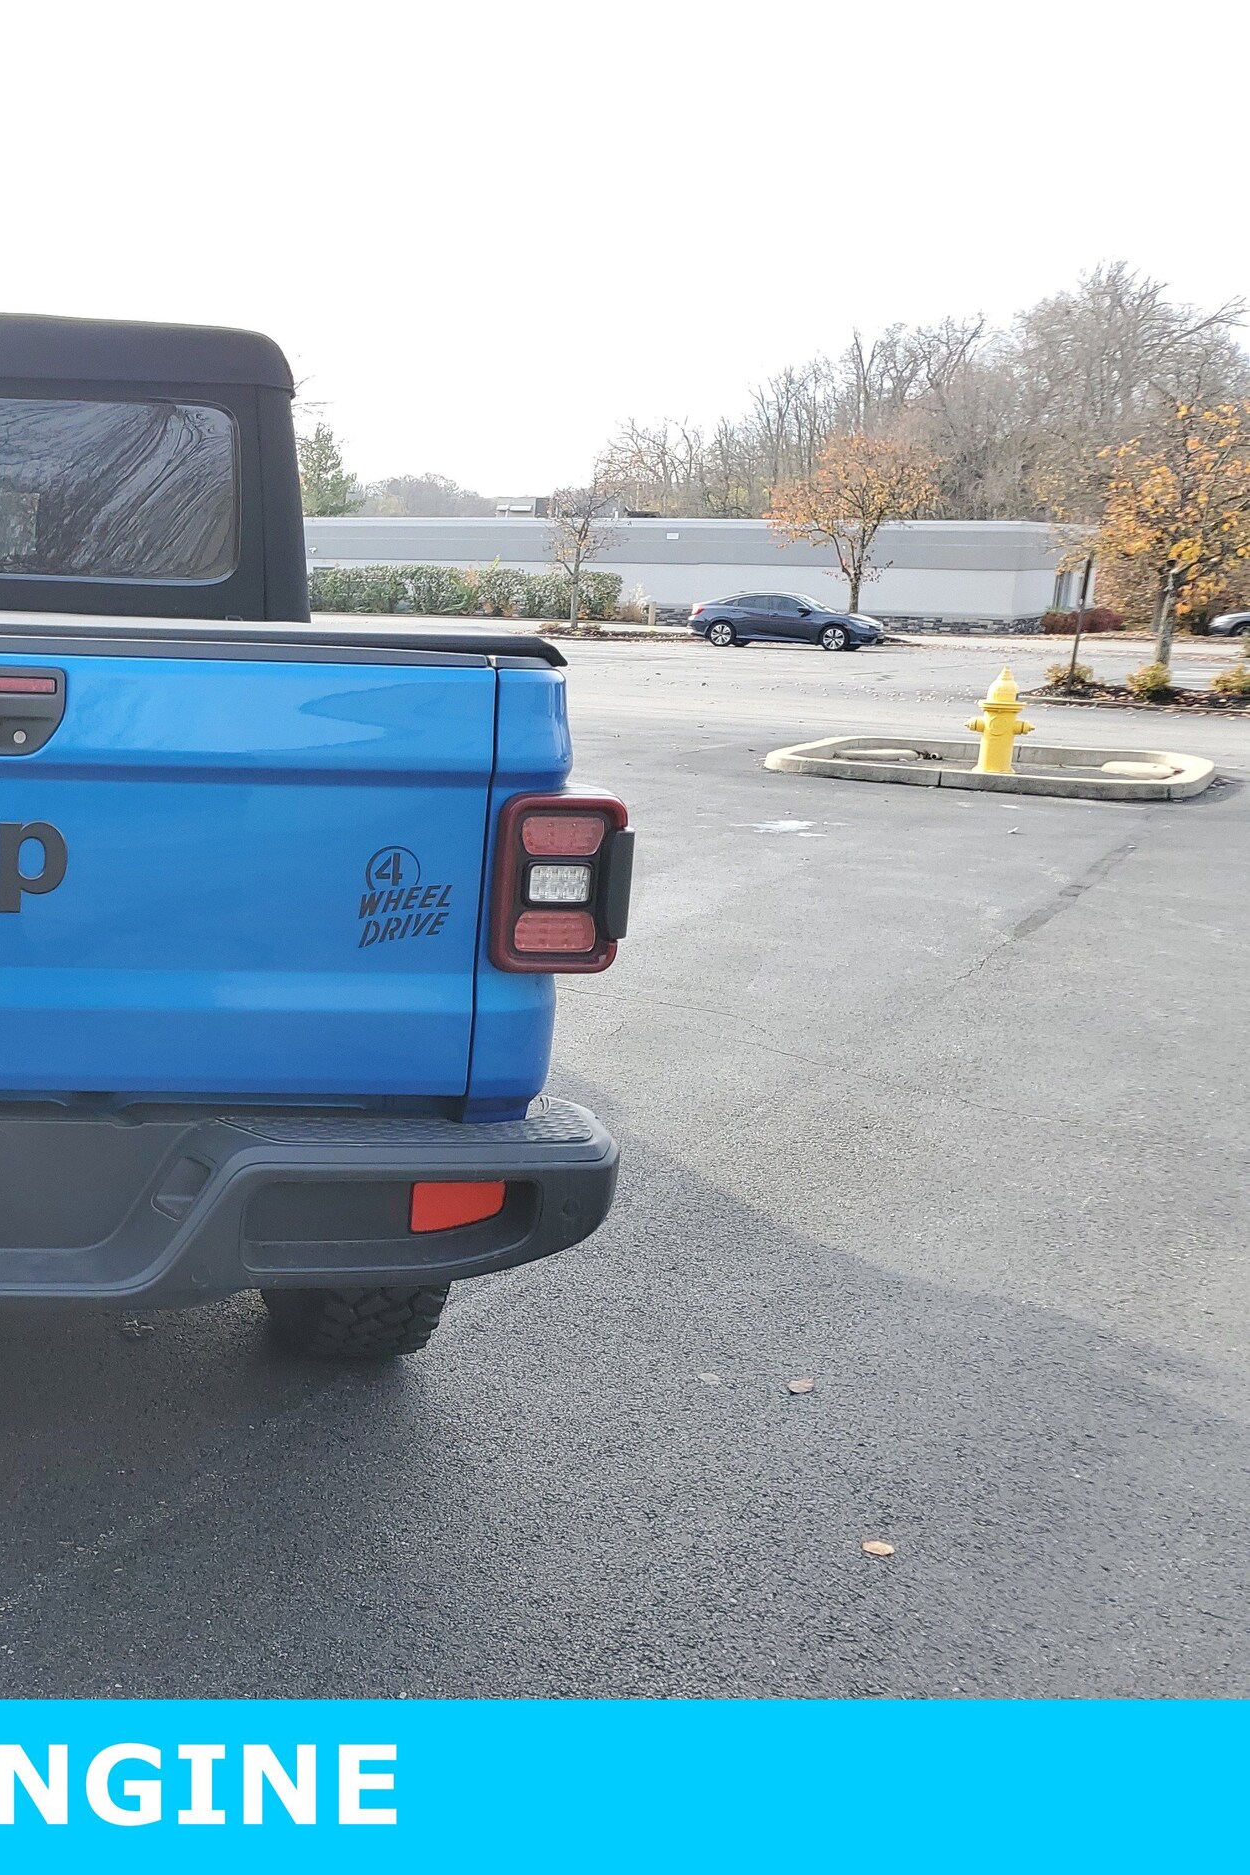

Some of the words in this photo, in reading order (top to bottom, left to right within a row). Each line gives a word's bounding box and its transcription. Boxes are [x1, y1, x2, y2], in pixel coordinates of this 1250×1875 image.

[374, 852, 403, 887] 4
[358, 884, 453, 919] WHEEL
[358, 912, 450, 949] DRIVE
